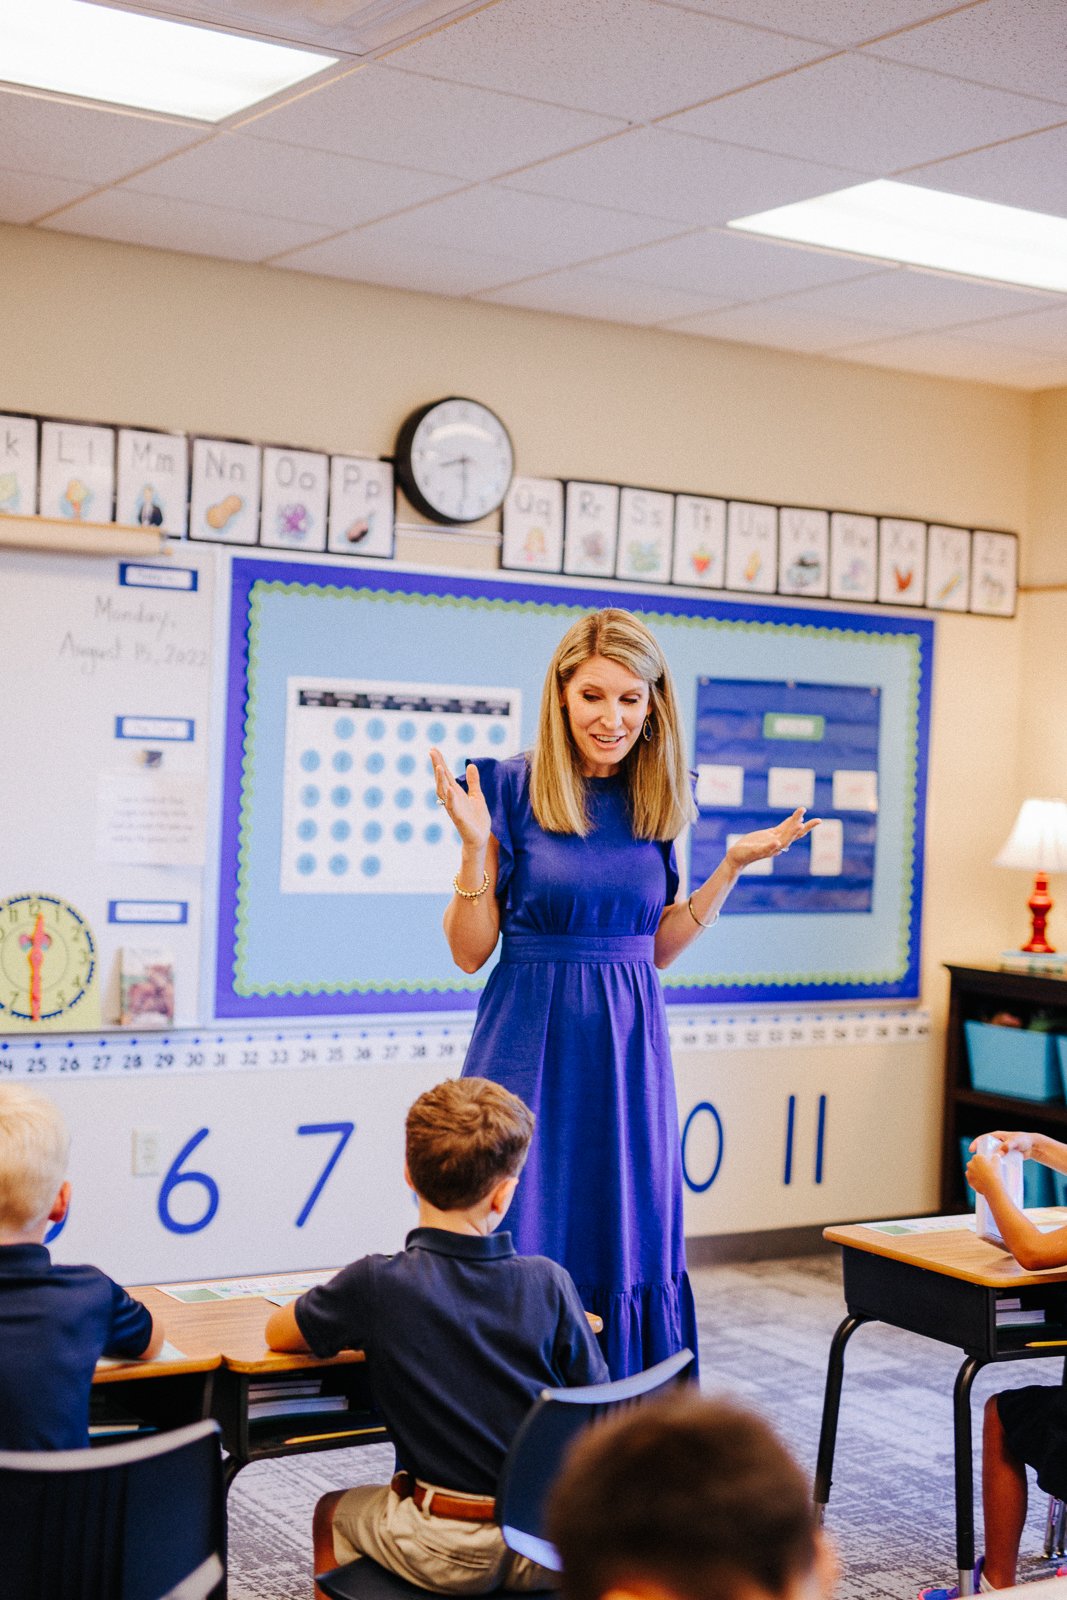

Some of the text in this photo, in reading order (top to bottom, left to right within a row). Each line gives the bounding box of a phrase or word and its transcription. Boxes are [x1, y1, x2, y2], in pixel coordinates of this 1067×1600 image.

[204, 449, 245, 480] Nn
[276, 455, 316, 490] Oo
[343, 464, 382, 503] Pp
[165, 643, 207, 667] 2022
[0, 1056, 13, 1073] 4
[26, 1056, 47, 1073] 25
[59, 1056, 80, 1073] 26
[93, 1054, 111, 1071] 27
[123, 1053, 142, 1070] 28
[155, 1052, 175, 1069] 29
[185, 1051, 204, 1068] 30
[213, 1051, 226, 1067] 31
[241, 1049, 258, 1066] 32
[270, 1048, 289, 1065] 33
[157, 1126, 219, 1235] 6
[297, 1122, 355, 1228] 7
[784, 1094, 827, 1185] 11
